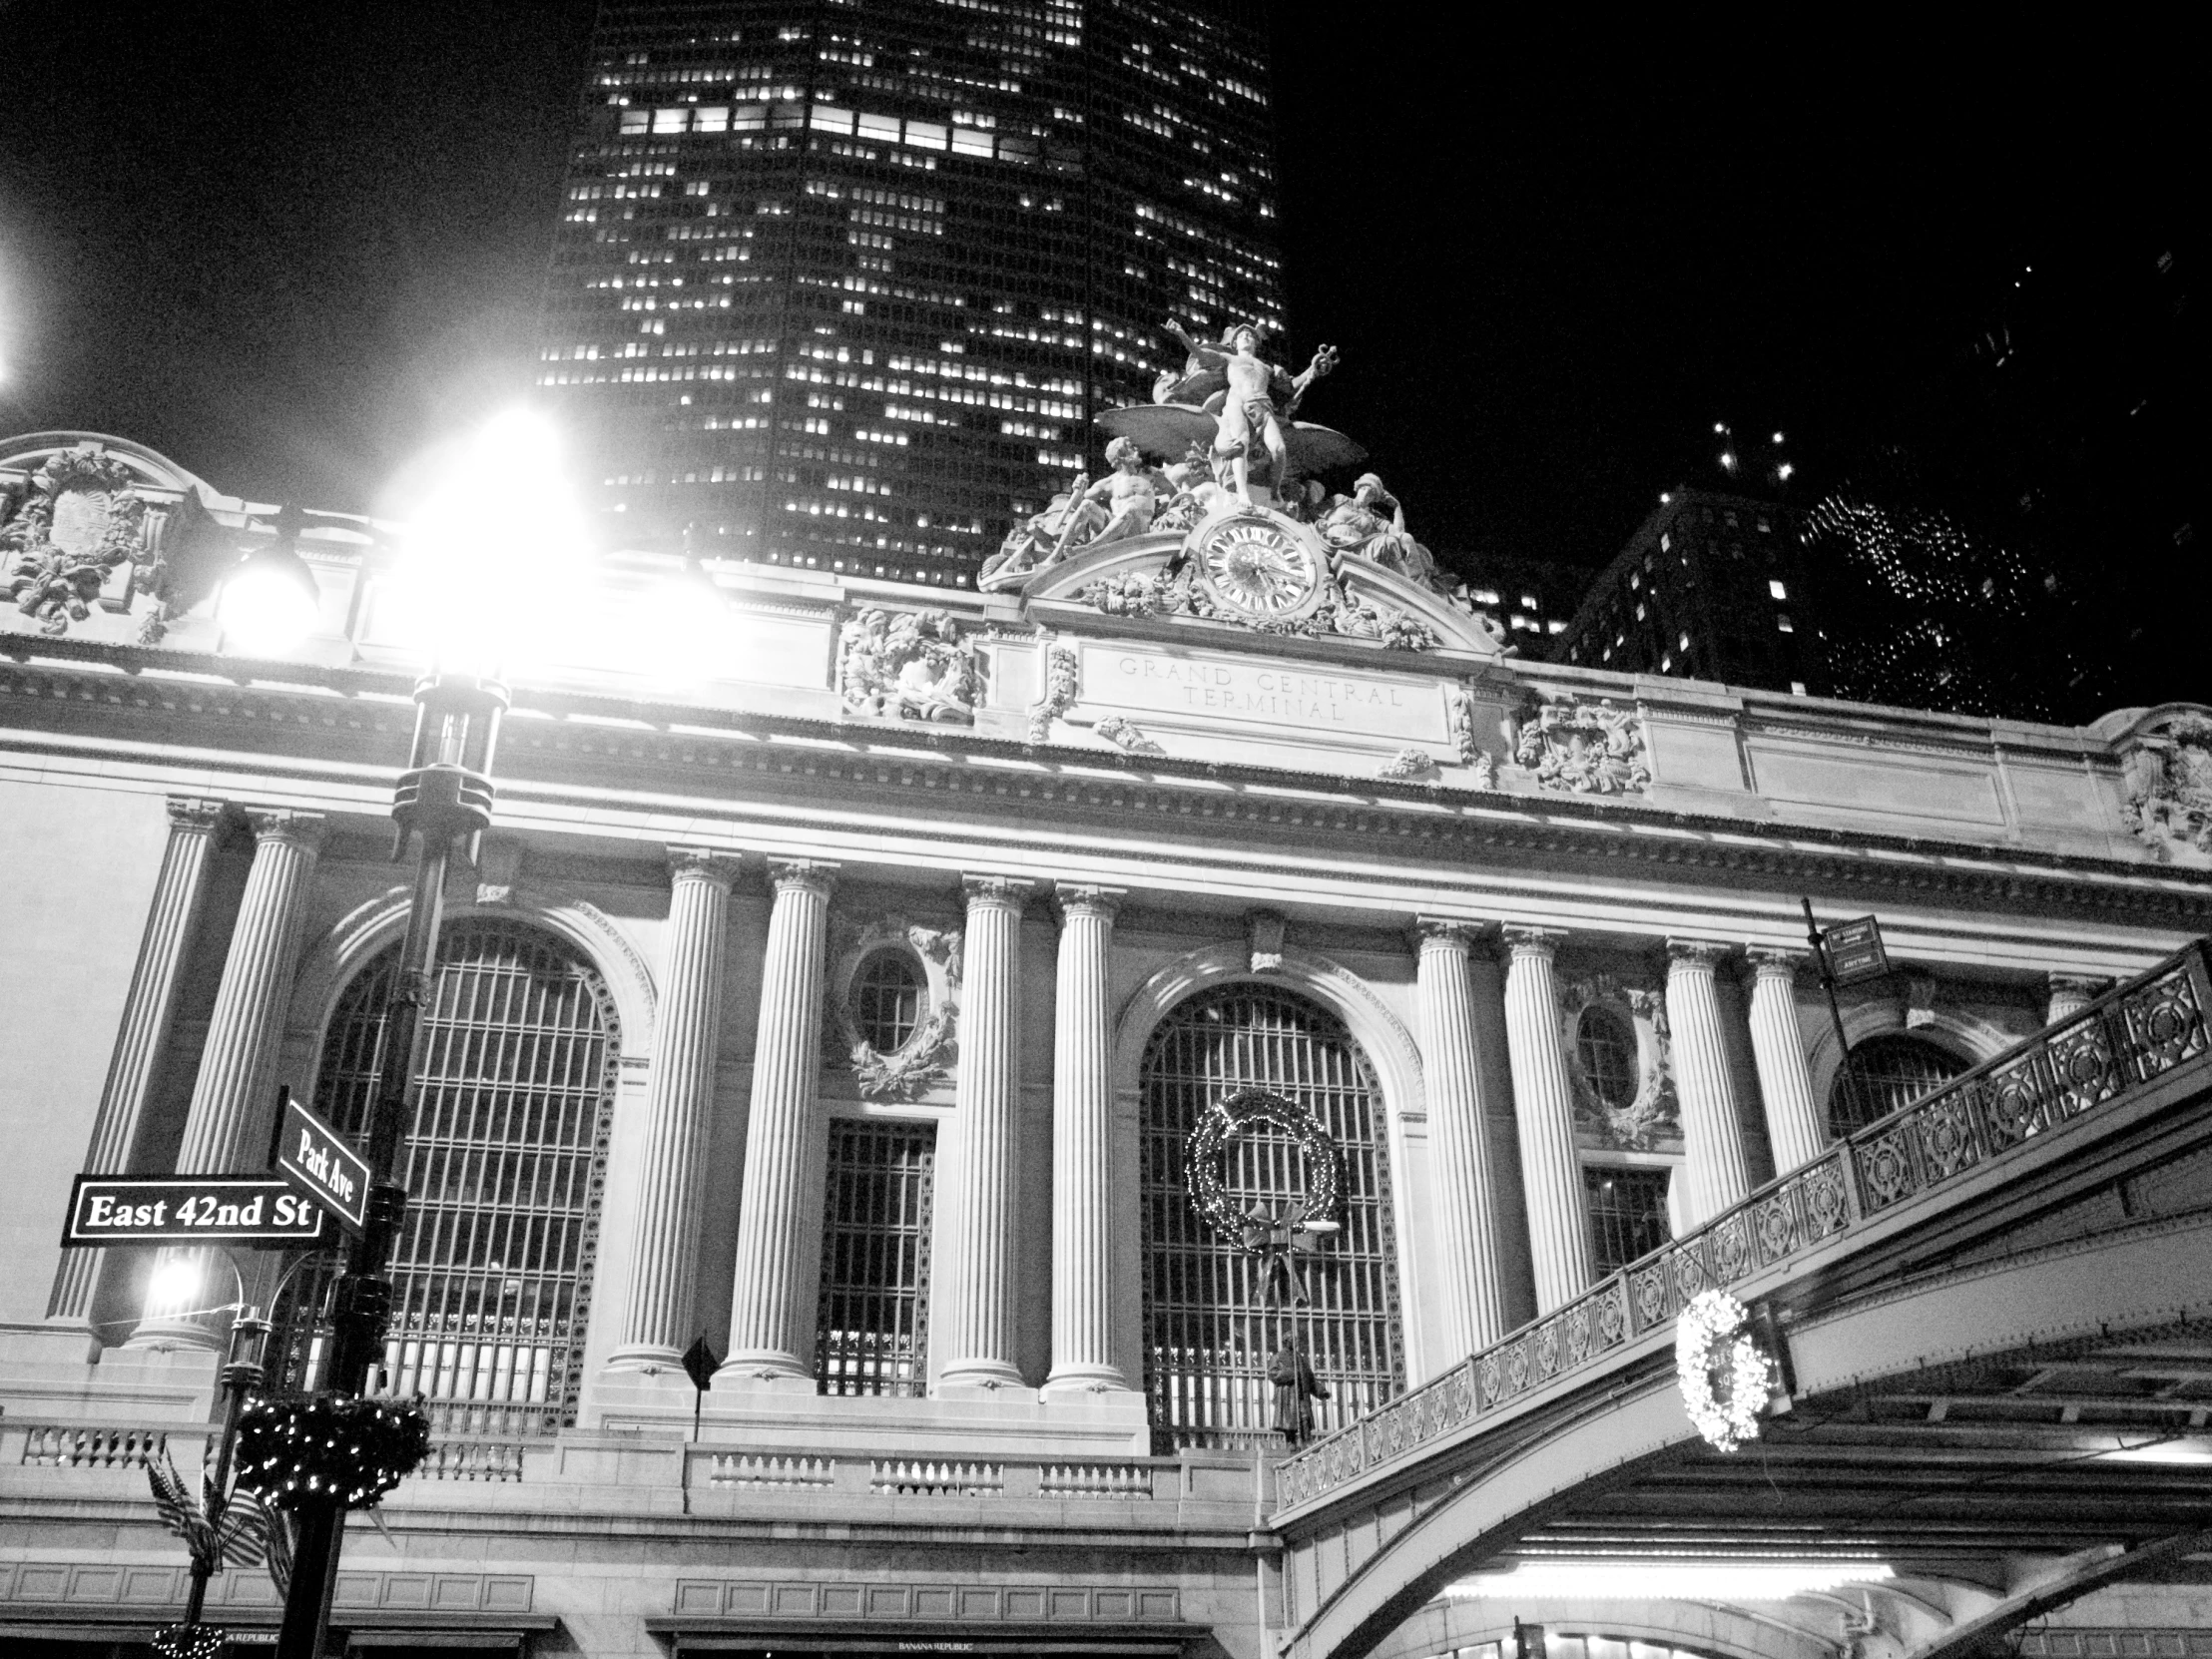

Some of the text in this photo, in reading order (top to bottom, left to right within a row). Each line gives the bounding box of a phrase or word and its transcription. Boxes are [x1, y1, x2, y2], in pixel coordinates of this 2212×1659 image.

[1119, 657, 1403, 708] GRAND CENTRAL
[1183, 685, 1346, 722] TERMINAL
[296, 1128, 353, 1203] Park Ave
[85, 1194, 311, 1227] East 42nd St
[236, 1633, 279, 1643] REPUBLIC
[898, 1642, 974, 1651] BANANA REPUBLIC
